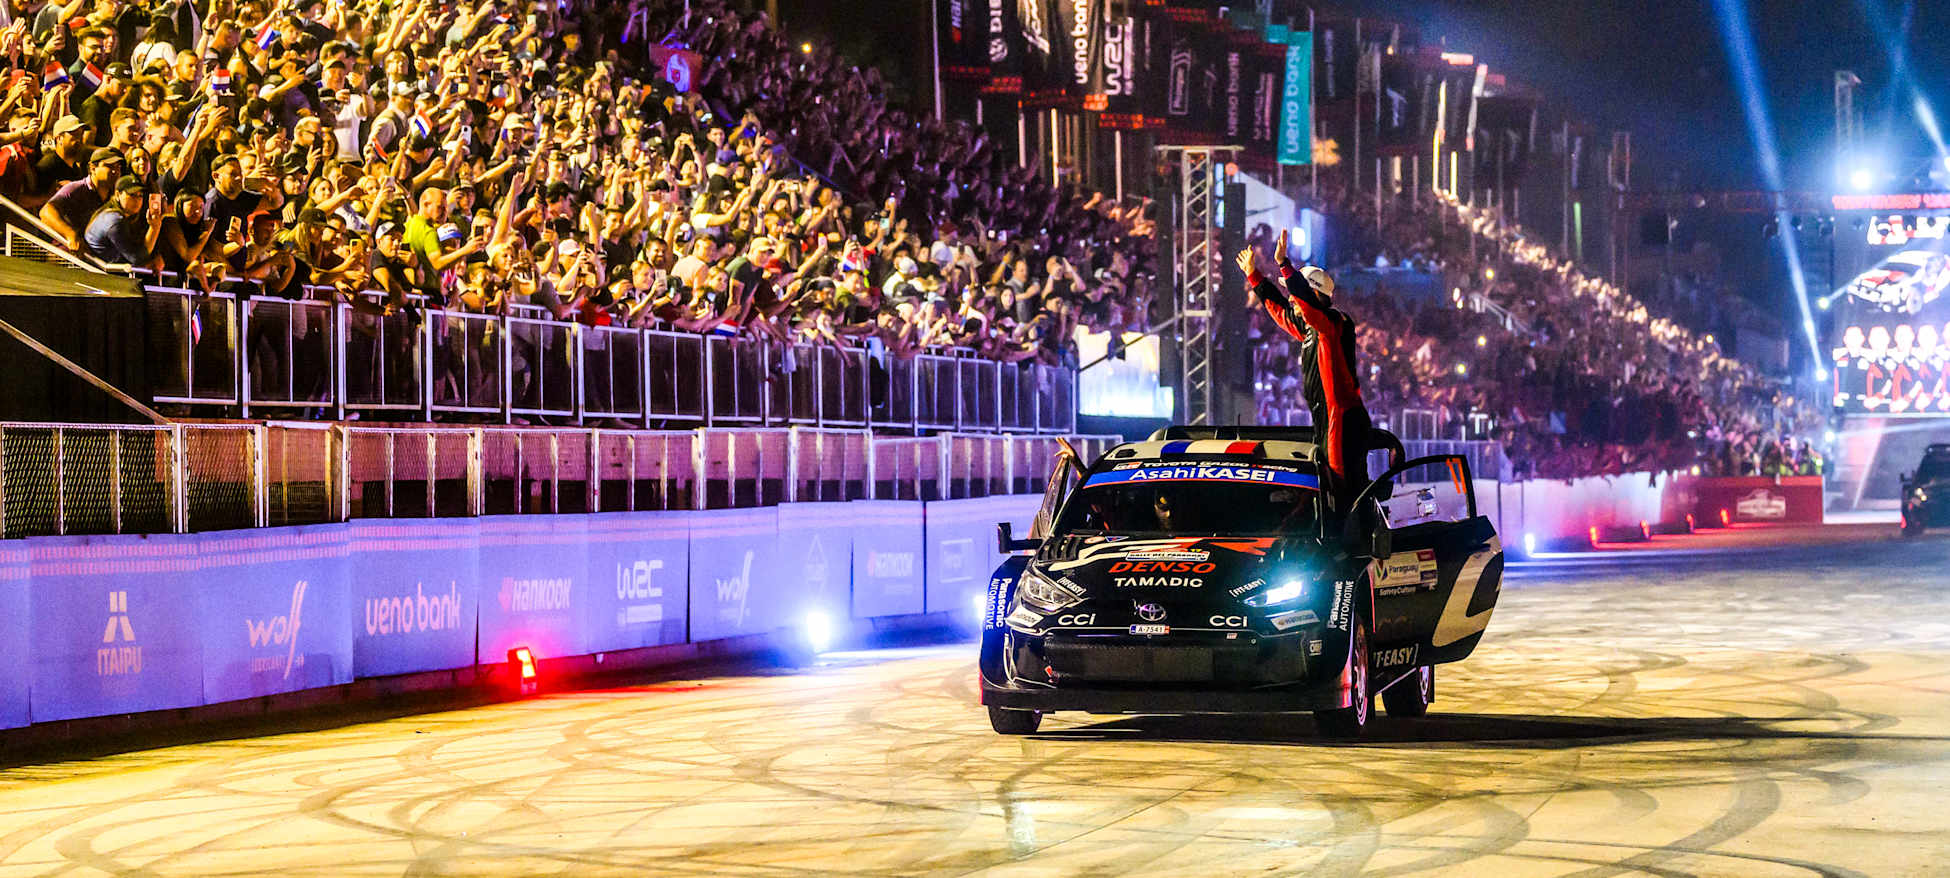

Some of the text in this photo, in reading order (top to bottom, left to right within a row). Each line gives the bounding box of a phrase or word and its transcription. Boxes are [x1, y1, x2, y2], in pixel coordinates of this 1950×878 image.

[1071, 0, 1088, 84] ueno ban
[1104, 24, 1122, 95] WRC
[1285, 45, 1300, 153] ueno bank
[1446, 458, 1467, 494] 17
[617, 560, 663, 599] WRC
[1108, 561, 1217, 574] DENSO
[1114, 577, 1203, 587] TAMADIC
[366, 580, 461, 636] ueno bank
[985, 578, 1000, 630] AUTOMOTIVE
[996, 578, 1012, 628] Panasonic
[1057, 613, 1096, 626] CCI
[1209, 615, 1248, 627] CCI
[1339, 580, 1354, 631] AUTOMOTIVE
[246, 580, 307, 680] wolf
[97, 647, 142, 676] ITAIPU
